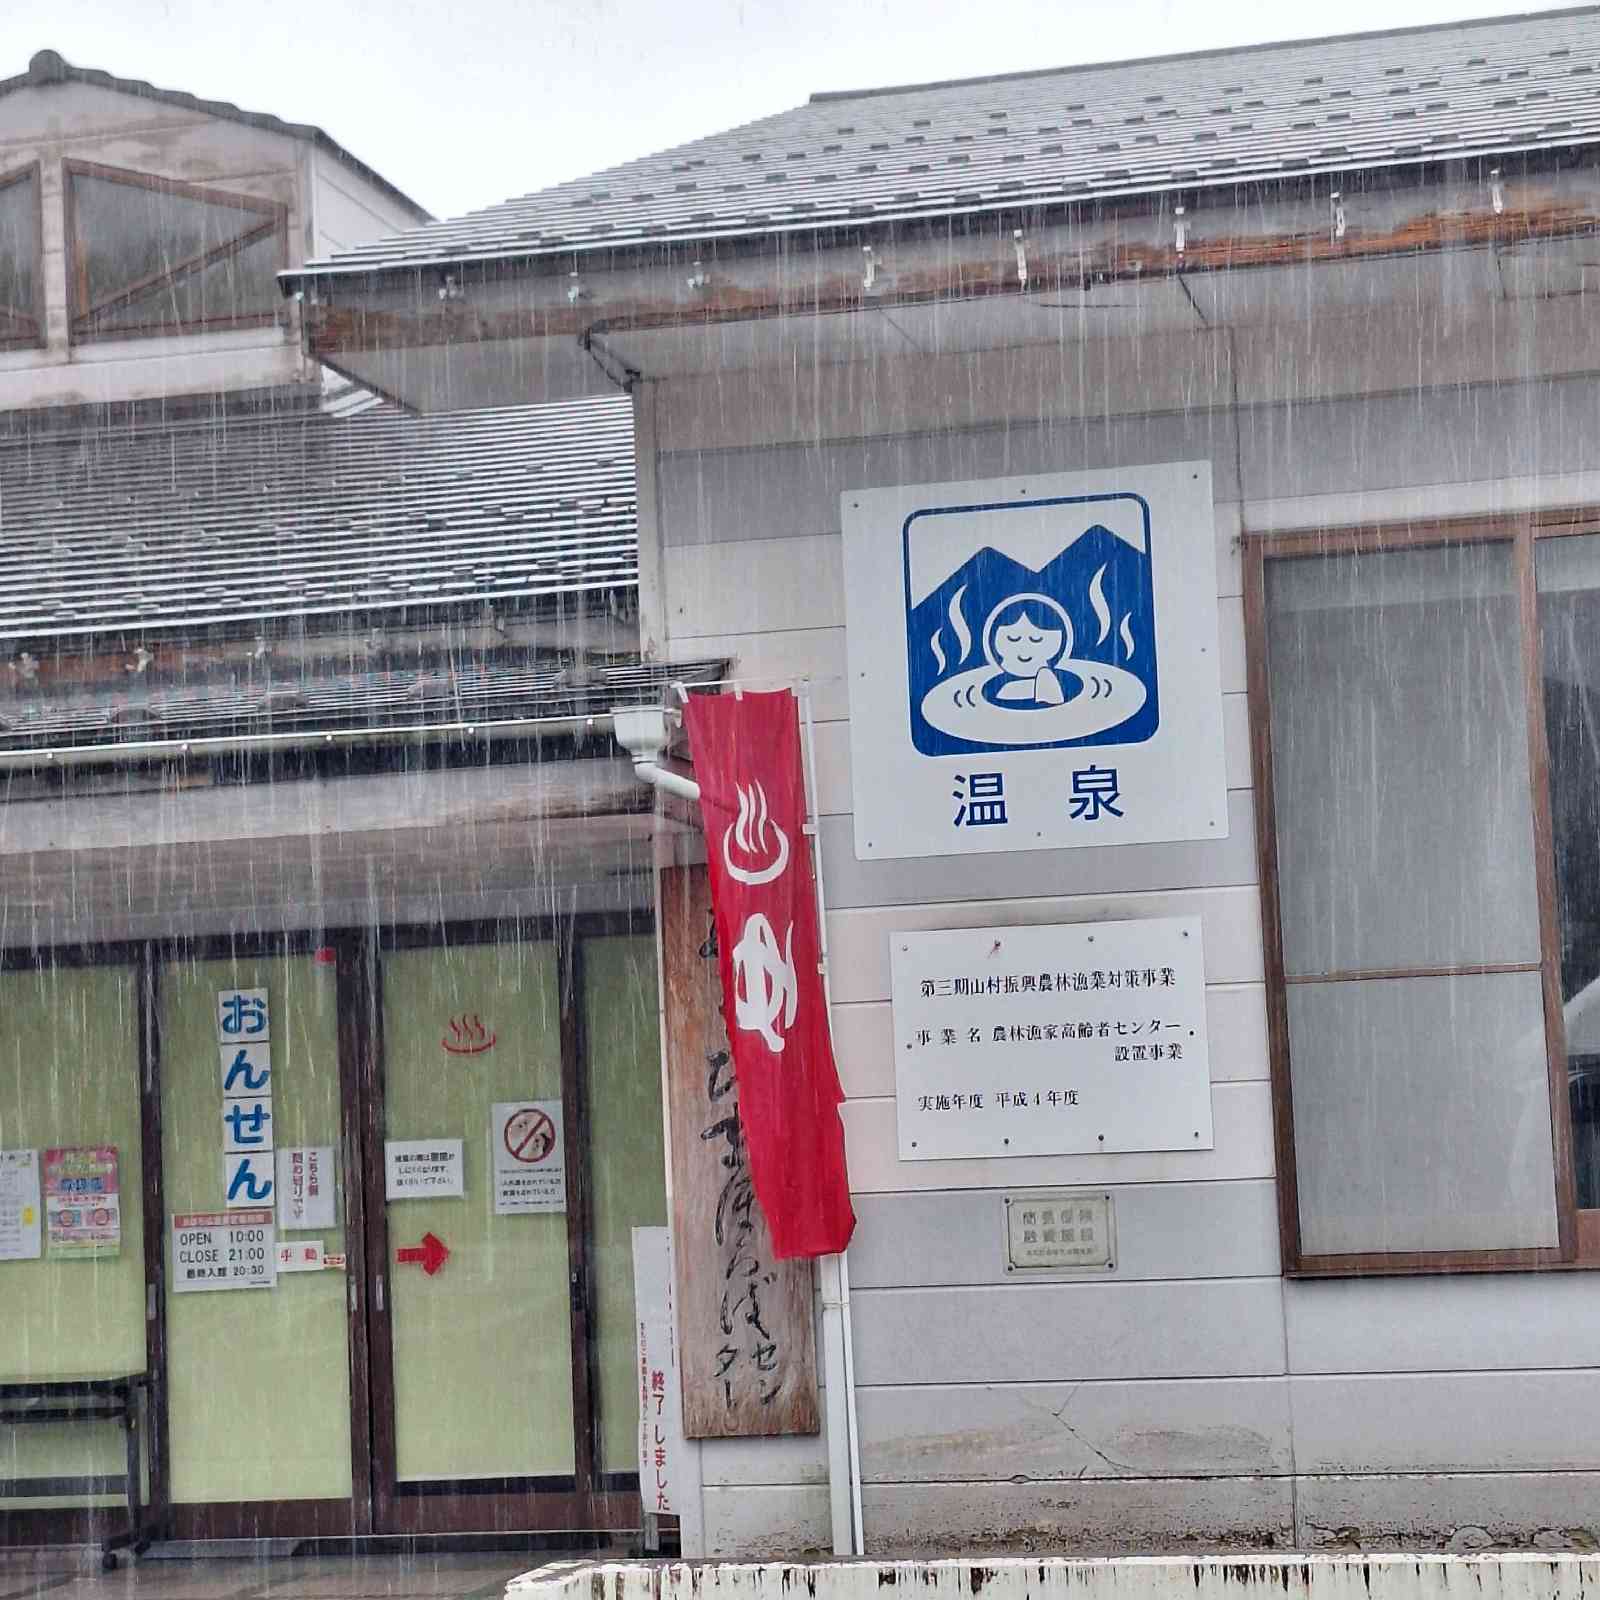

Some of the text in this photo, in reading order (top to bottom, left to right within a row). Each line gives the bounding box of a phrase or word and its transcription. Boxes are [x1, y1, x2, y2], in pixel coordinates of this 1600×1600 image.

[952, 764, 1124, 827] 温泉
[732, 912, 798, 1053] ゆ
[916, 1027, 982, 1046] 事業名
[1114, 1043, 1184, 1062] 設置事業
[221, 994, 272, 1201] おんせん
[917, 1092, 985, 1112] 実施年度
[179, 1229, 264, 1246] OPEN 10:00
[179, 1246, 265, 1264] CLOSE 21:00
